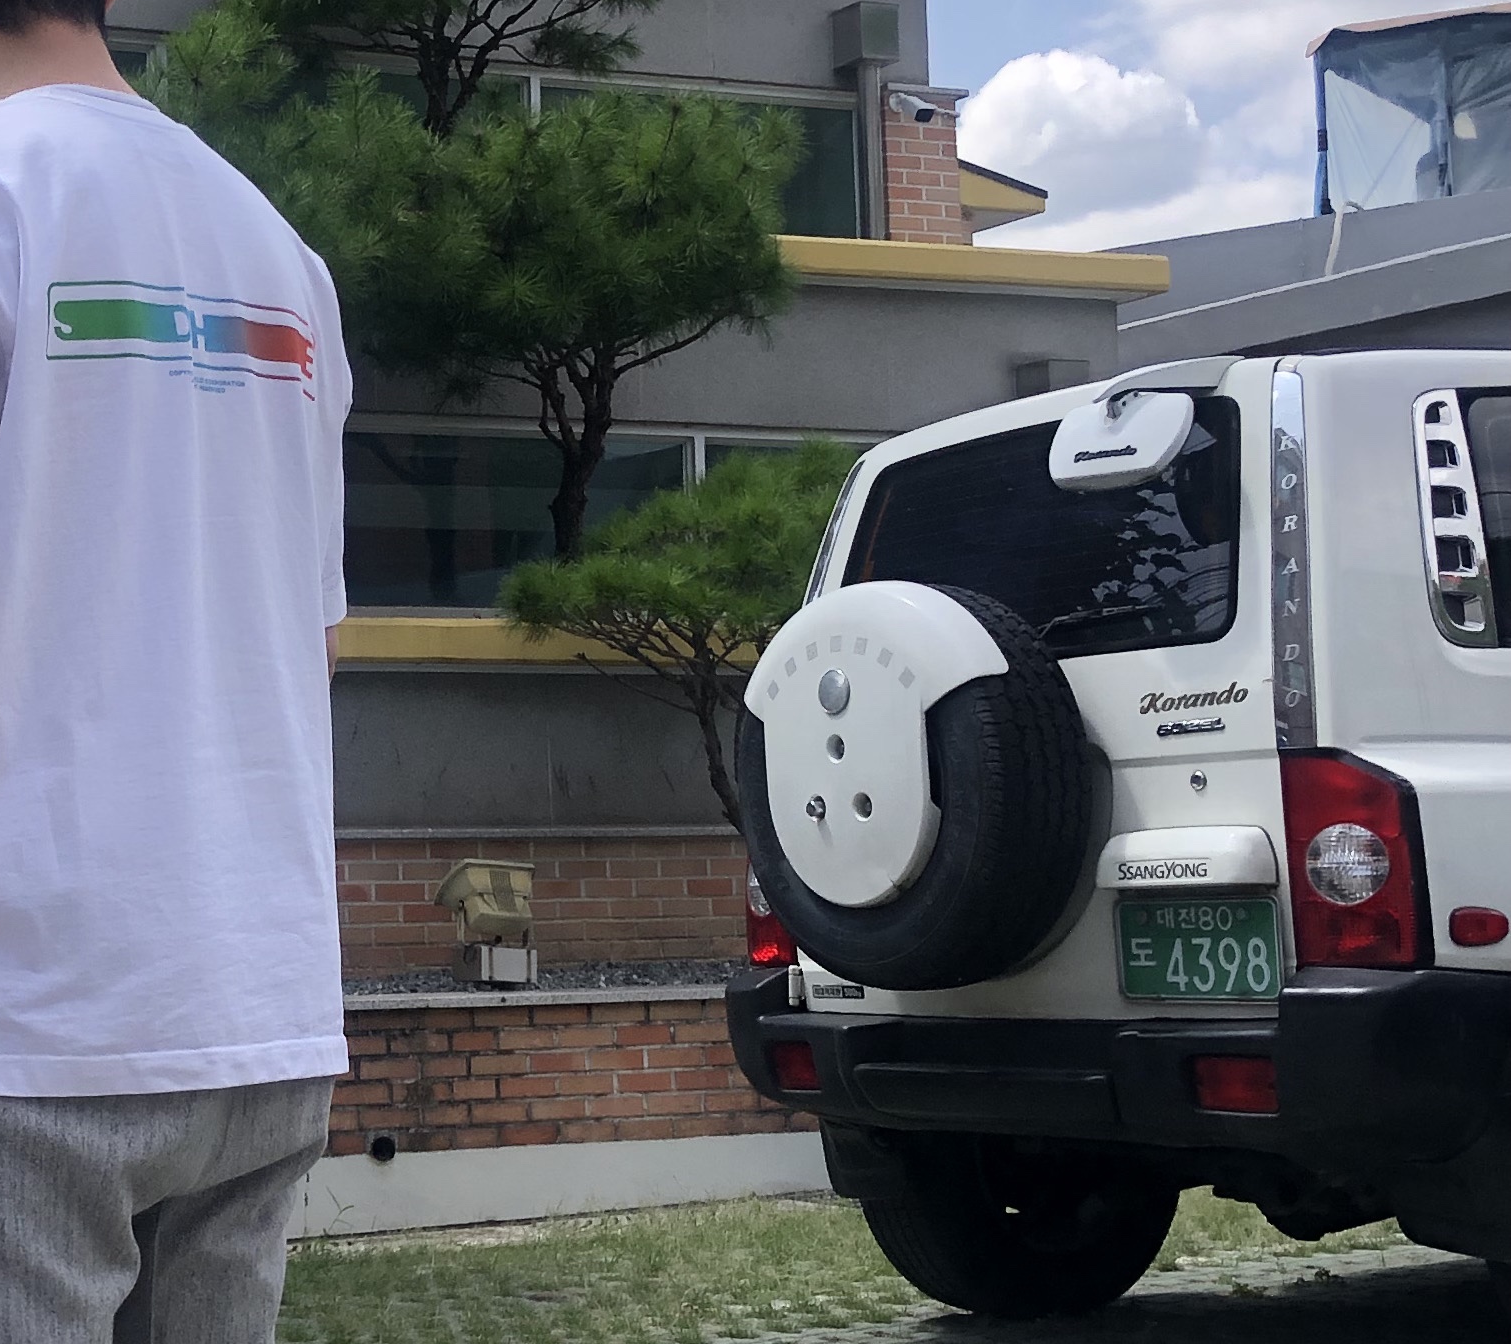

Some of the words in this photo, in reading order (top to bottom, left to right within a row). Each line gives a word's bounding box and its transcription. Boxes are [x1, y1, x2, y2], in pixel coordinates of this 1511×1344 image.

[1139, 681, 1248, 715] Korando
[1129, 937, 1157, 967] 도
[1166, 936, 1271, 993] 4398
